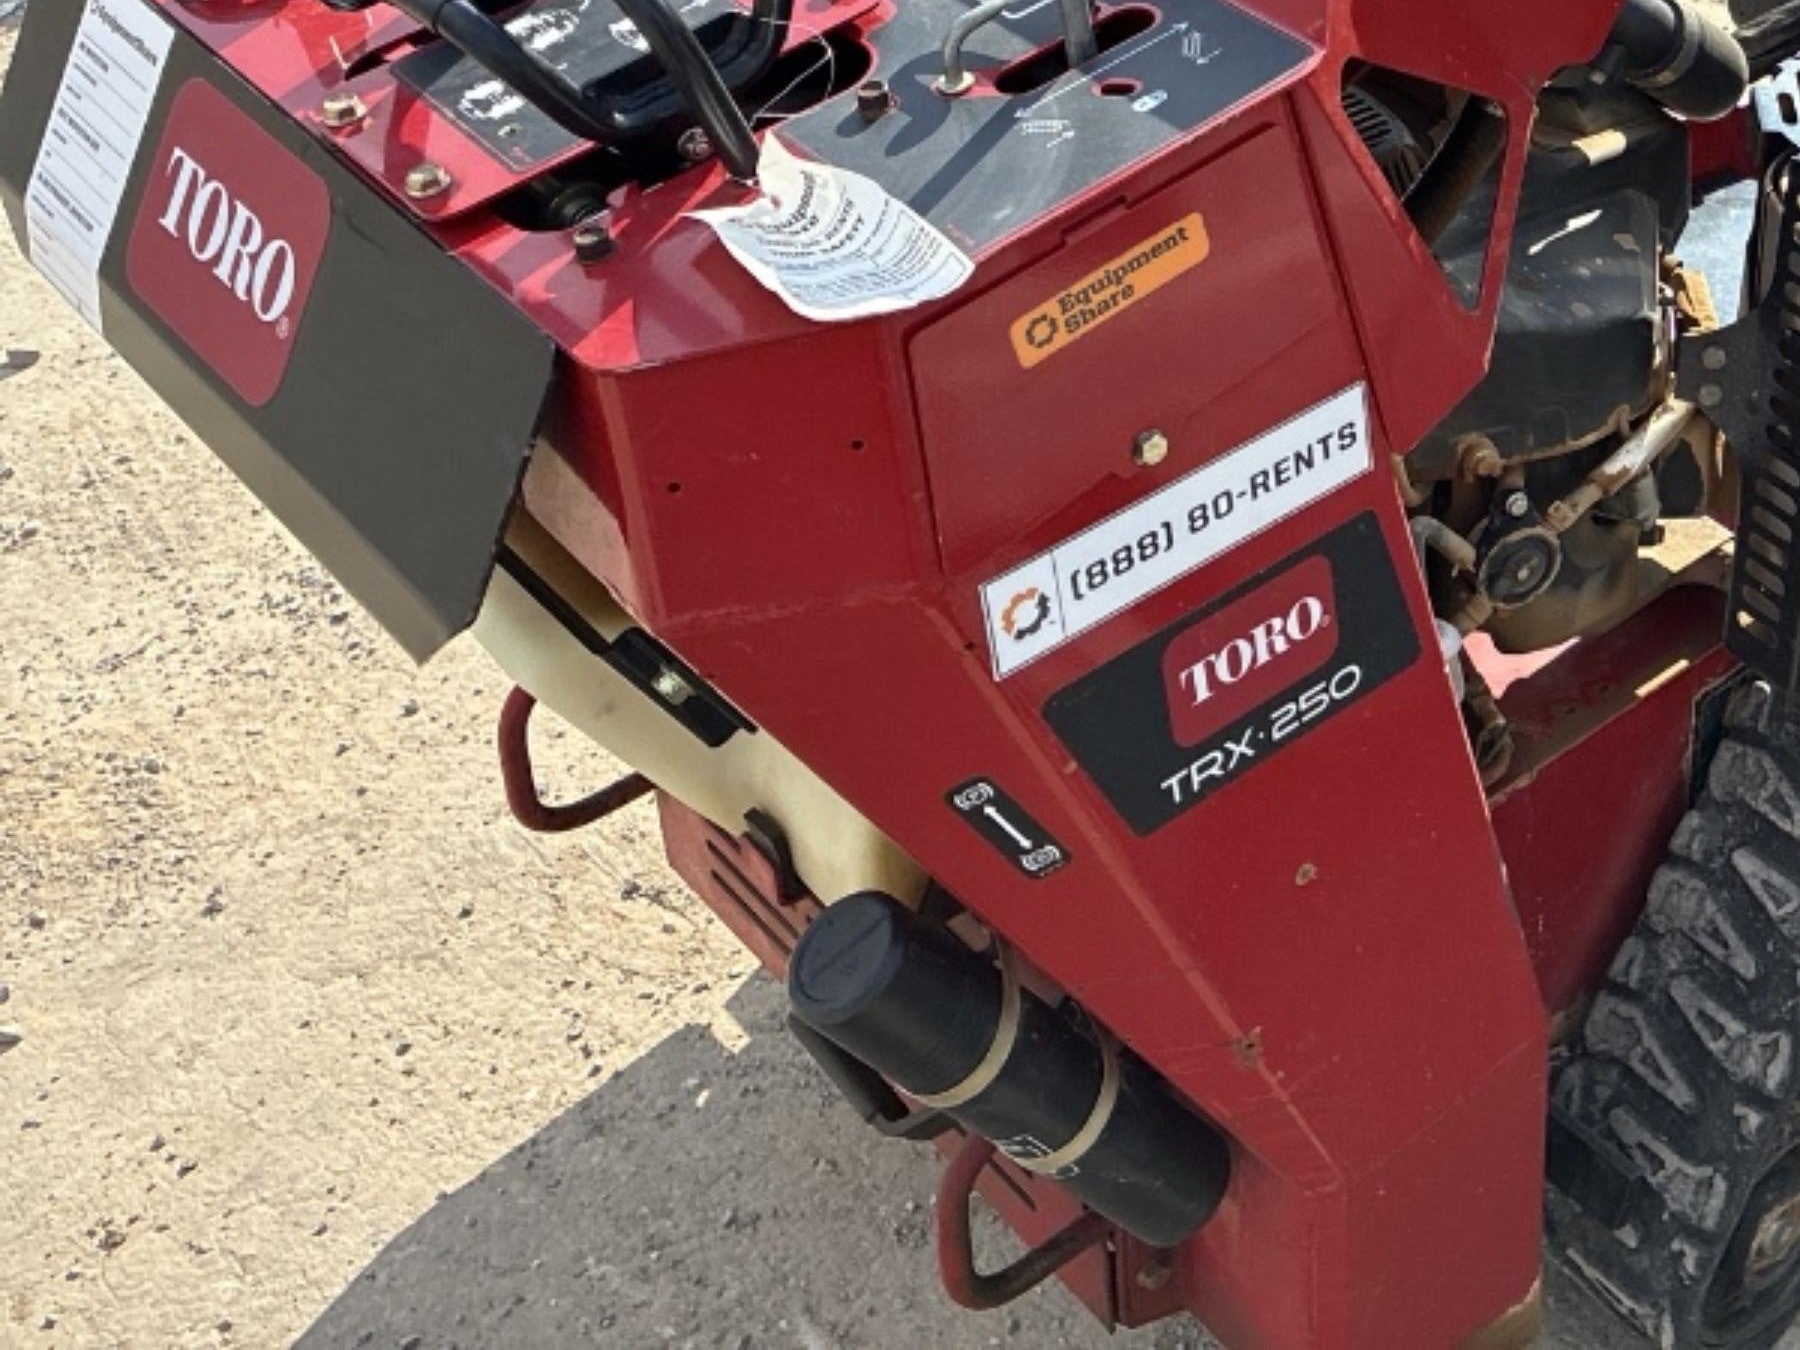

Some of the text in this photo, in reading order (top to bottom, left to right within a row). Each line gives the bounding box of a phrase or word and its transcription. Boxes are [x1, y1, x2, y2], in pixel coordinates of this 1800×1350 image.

[158, 146, 295, 323] TORO
[1057, 226, 1189, 316] Equipment
[1063, 283, 1135, 334] Share
[1069, 421, 1358, 601] (888) 80-RENTS
[1178, 596, 1323, 708] TORO
